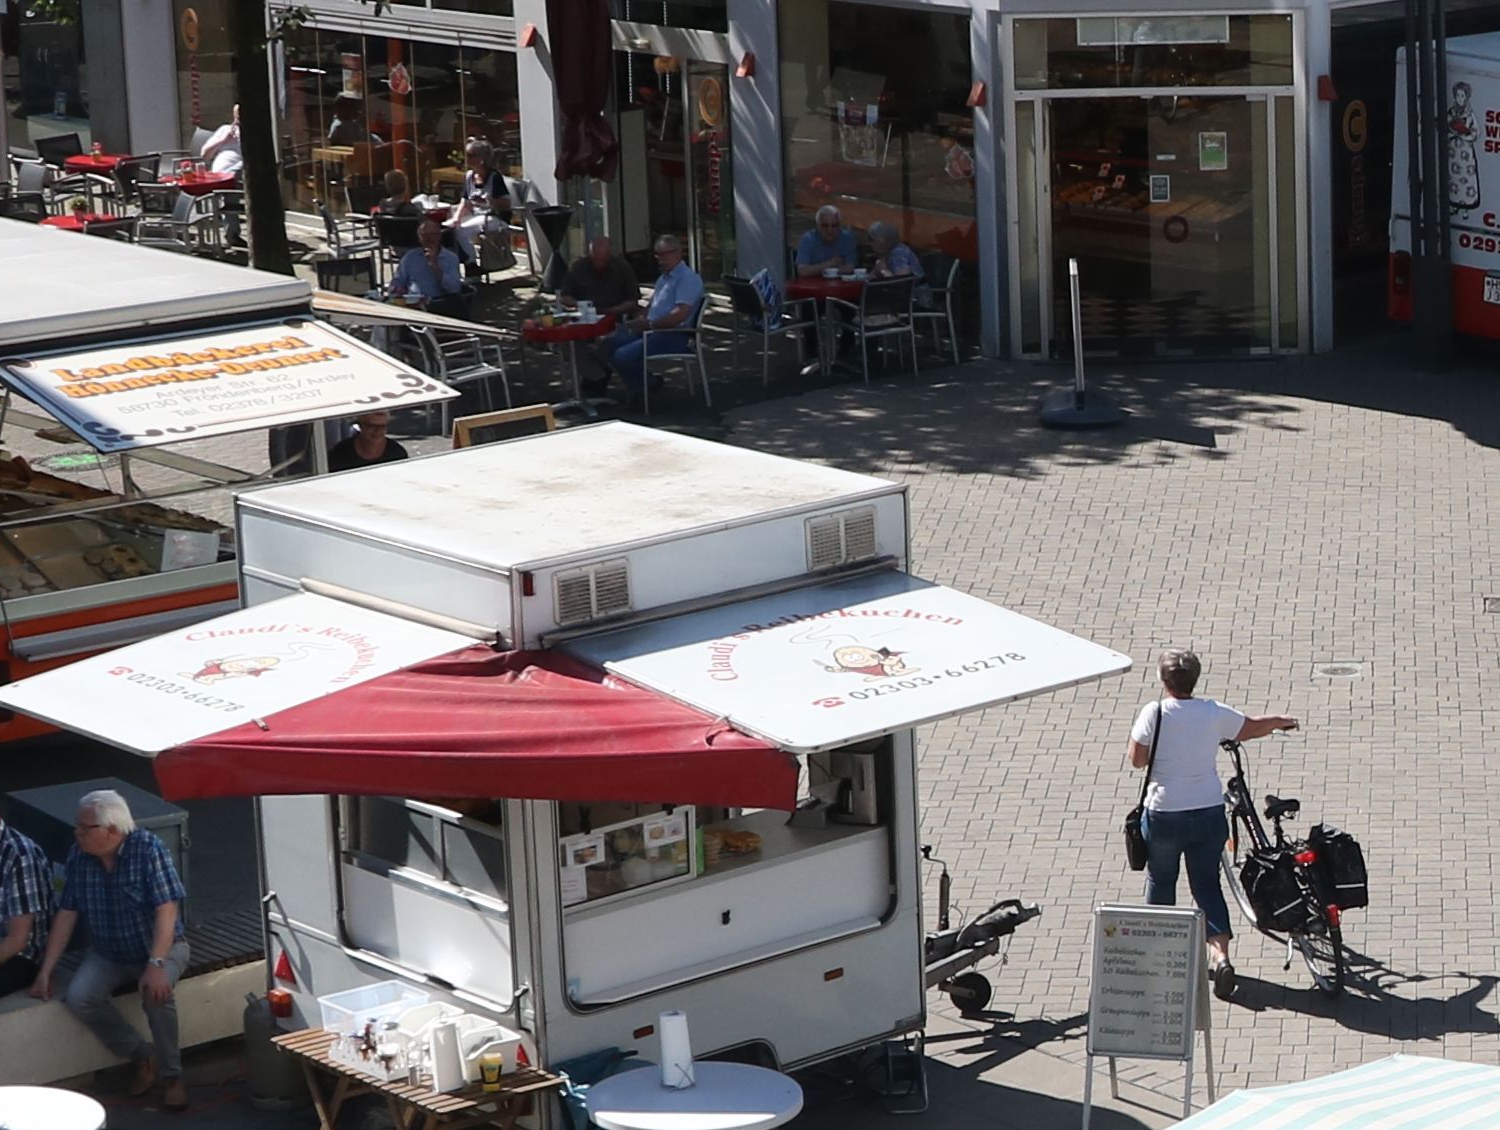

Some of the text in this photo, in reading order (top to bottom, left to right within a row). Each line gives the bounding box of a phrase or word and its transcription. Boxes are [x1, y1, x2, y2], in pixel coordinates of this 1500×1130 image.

[1483, 213, 1500, 230] C.
[51, 335, 313, 383] Landbäckerei
[57, 347, 348, 398] Hönnecke-Deunert
[156, 384, 221, 399] Ardeyer
[117, 400, 177, 415] 58730
[741, 607, 964, 633] Reibekuchen
[316, 626, 380, 683] Reibekuchen
